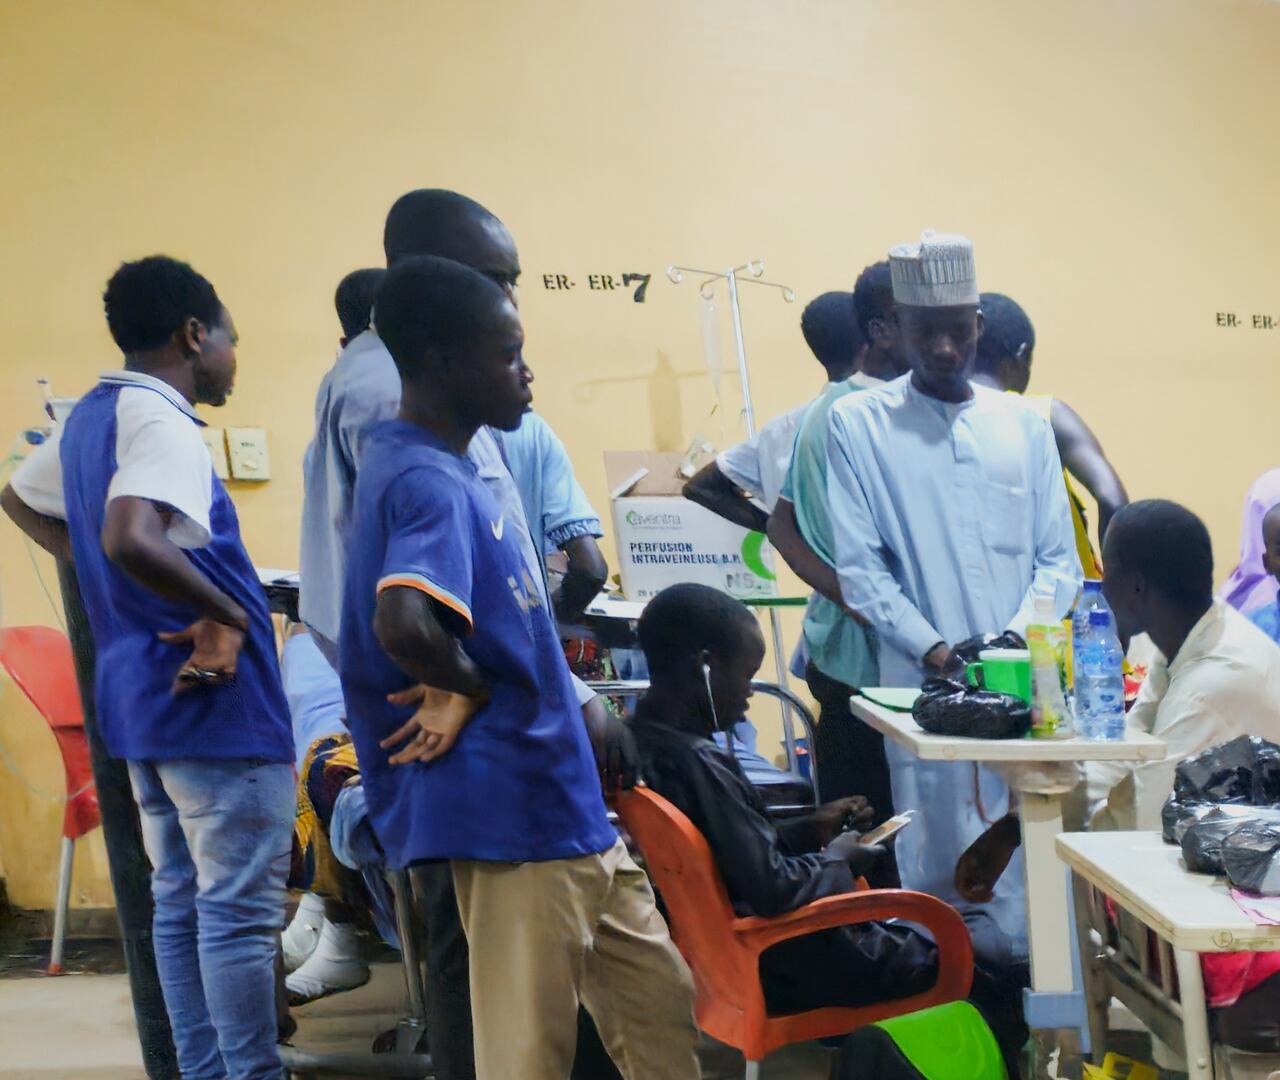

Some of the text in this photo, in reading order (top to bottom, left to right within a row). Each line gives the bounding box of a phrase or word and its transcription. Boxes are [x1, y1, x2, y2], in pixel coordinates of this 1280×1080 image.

[543, 272, 652, 304] ER- ER-7
[630, 543, 693, 553] PERFUSION
